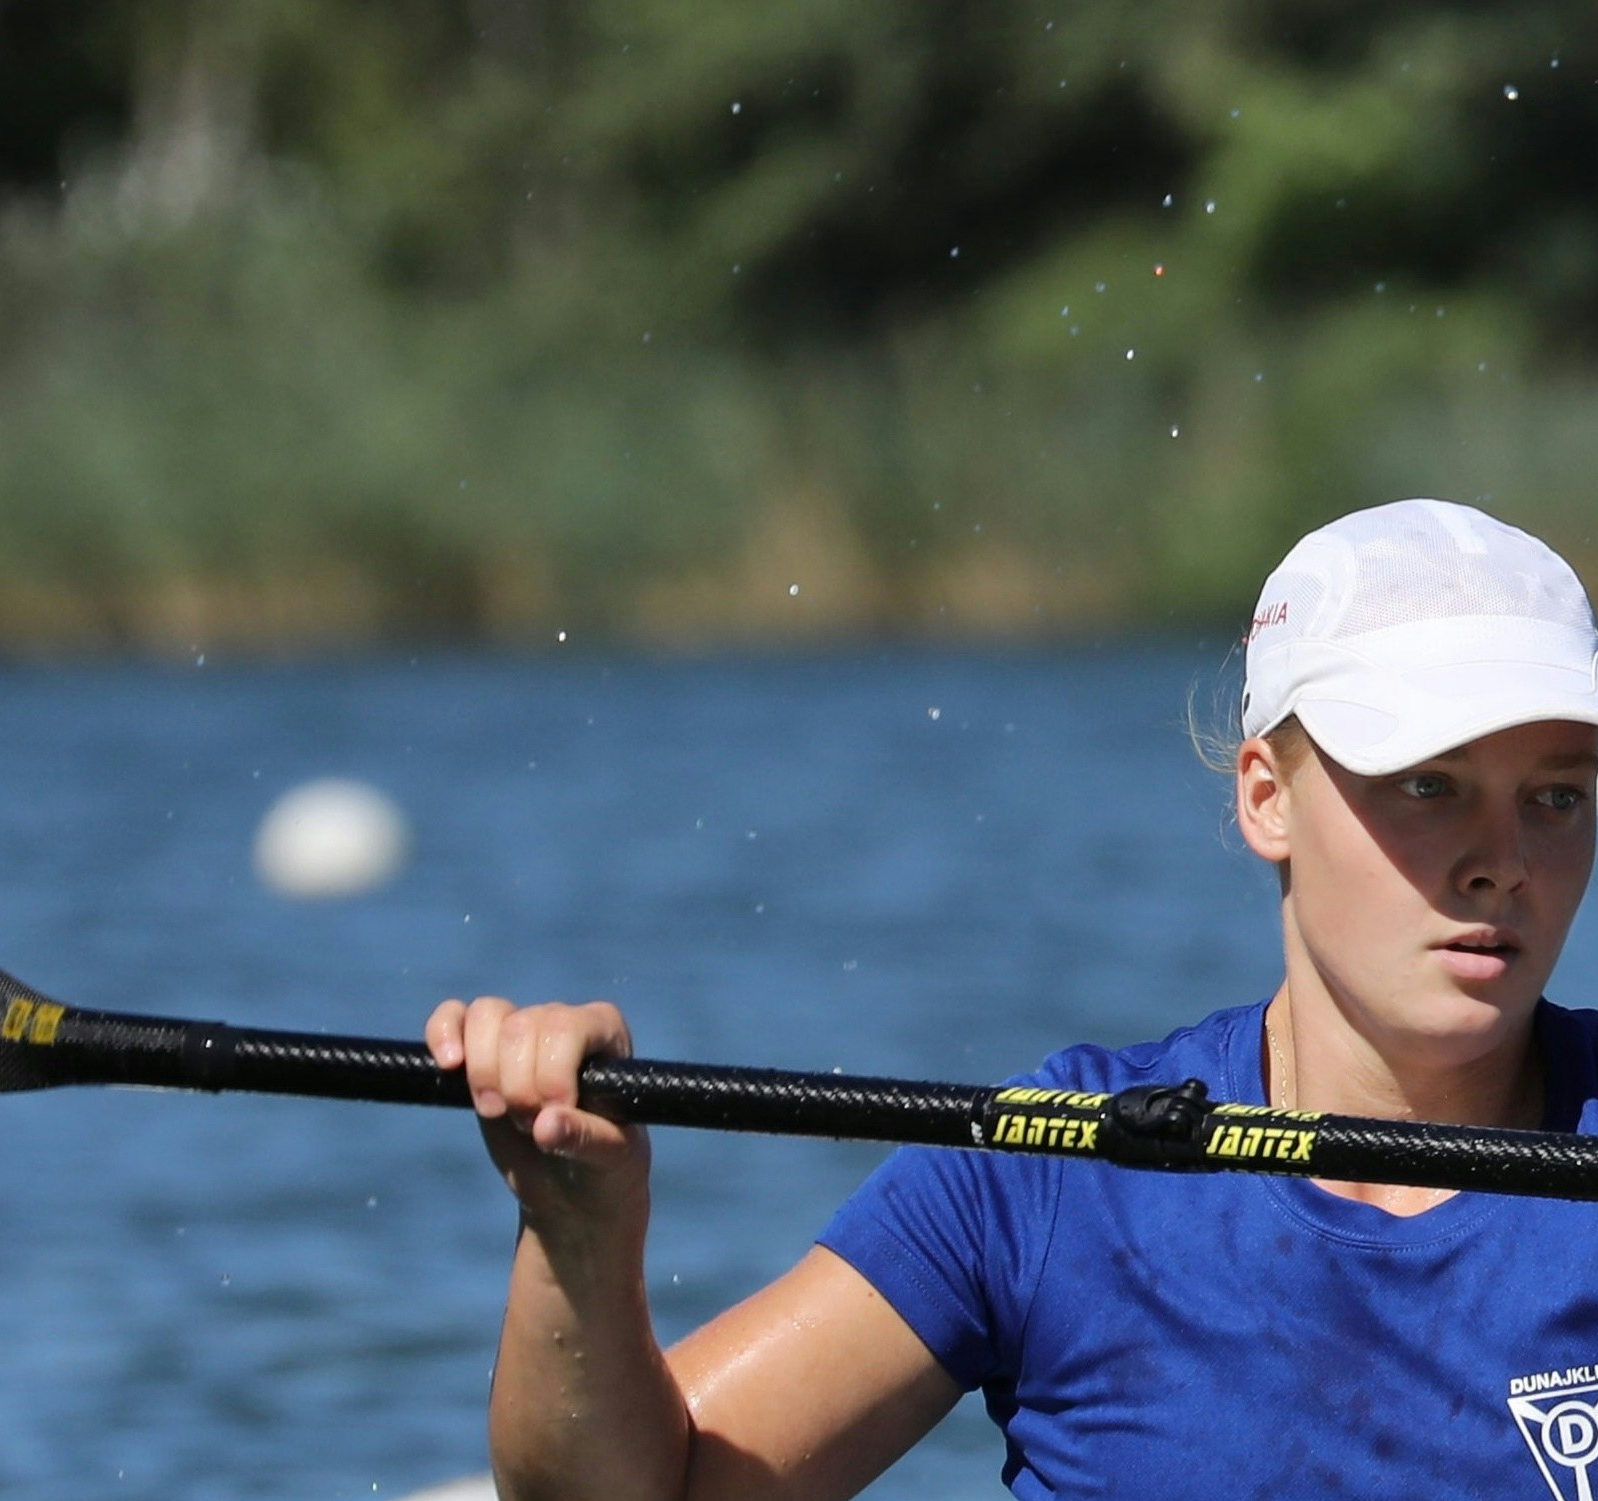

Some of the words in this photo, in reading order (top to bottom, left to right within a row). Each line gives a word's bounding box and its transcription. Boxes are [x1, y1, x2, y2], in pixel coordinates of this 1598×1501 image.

[992, 1114, 1099, 1149] JANTEX
[1206, 1125, 1316, 1161] JANTEX
[1557, 1413, 1595, 1456] D
